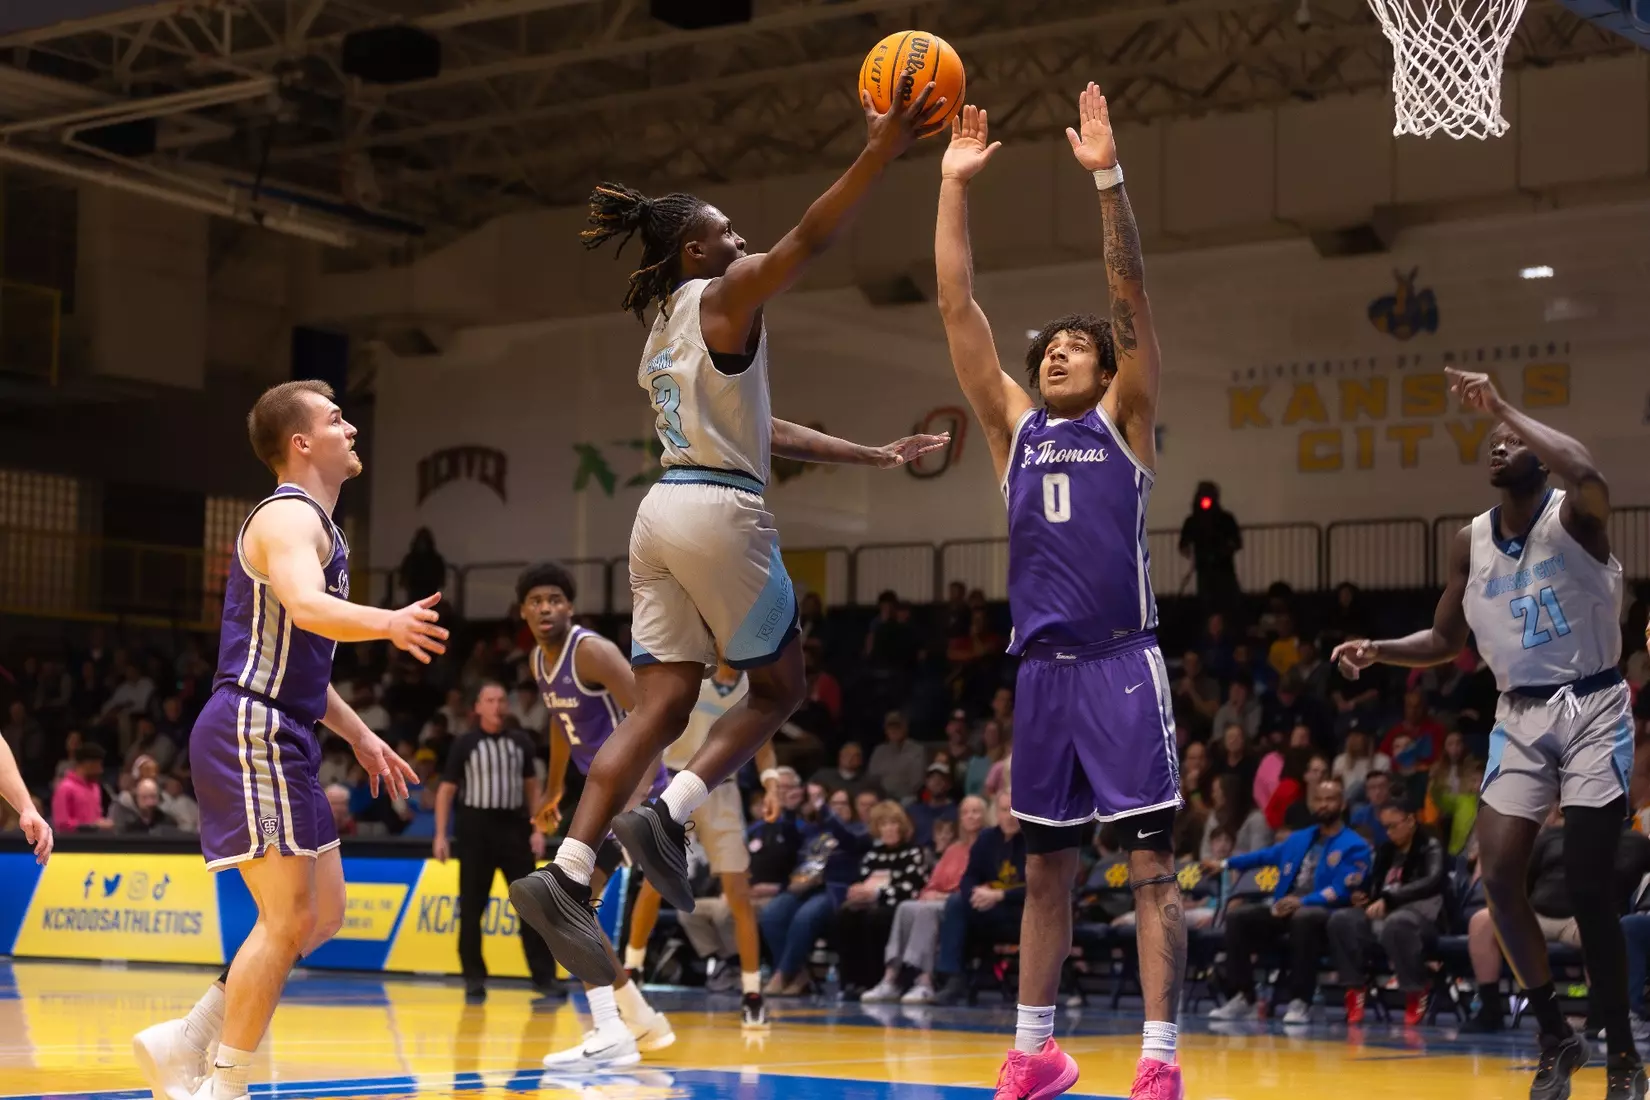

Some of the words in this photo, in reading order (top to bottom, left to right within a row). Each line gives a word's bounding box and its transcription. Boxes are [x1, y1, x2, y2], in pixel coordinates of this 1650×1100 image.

[901, 37, 930, 102] Wilson
[1035, 440, 1109, 466] Thomas
[1297, 416, 1494, 474] CITY
[1042, 472, 1071, 524] 0
[1509, 585, 1571, 650] 21
[559, 712, 581, 746] 2
[42, 907, 204, 935] KCROOSATHLETICS
